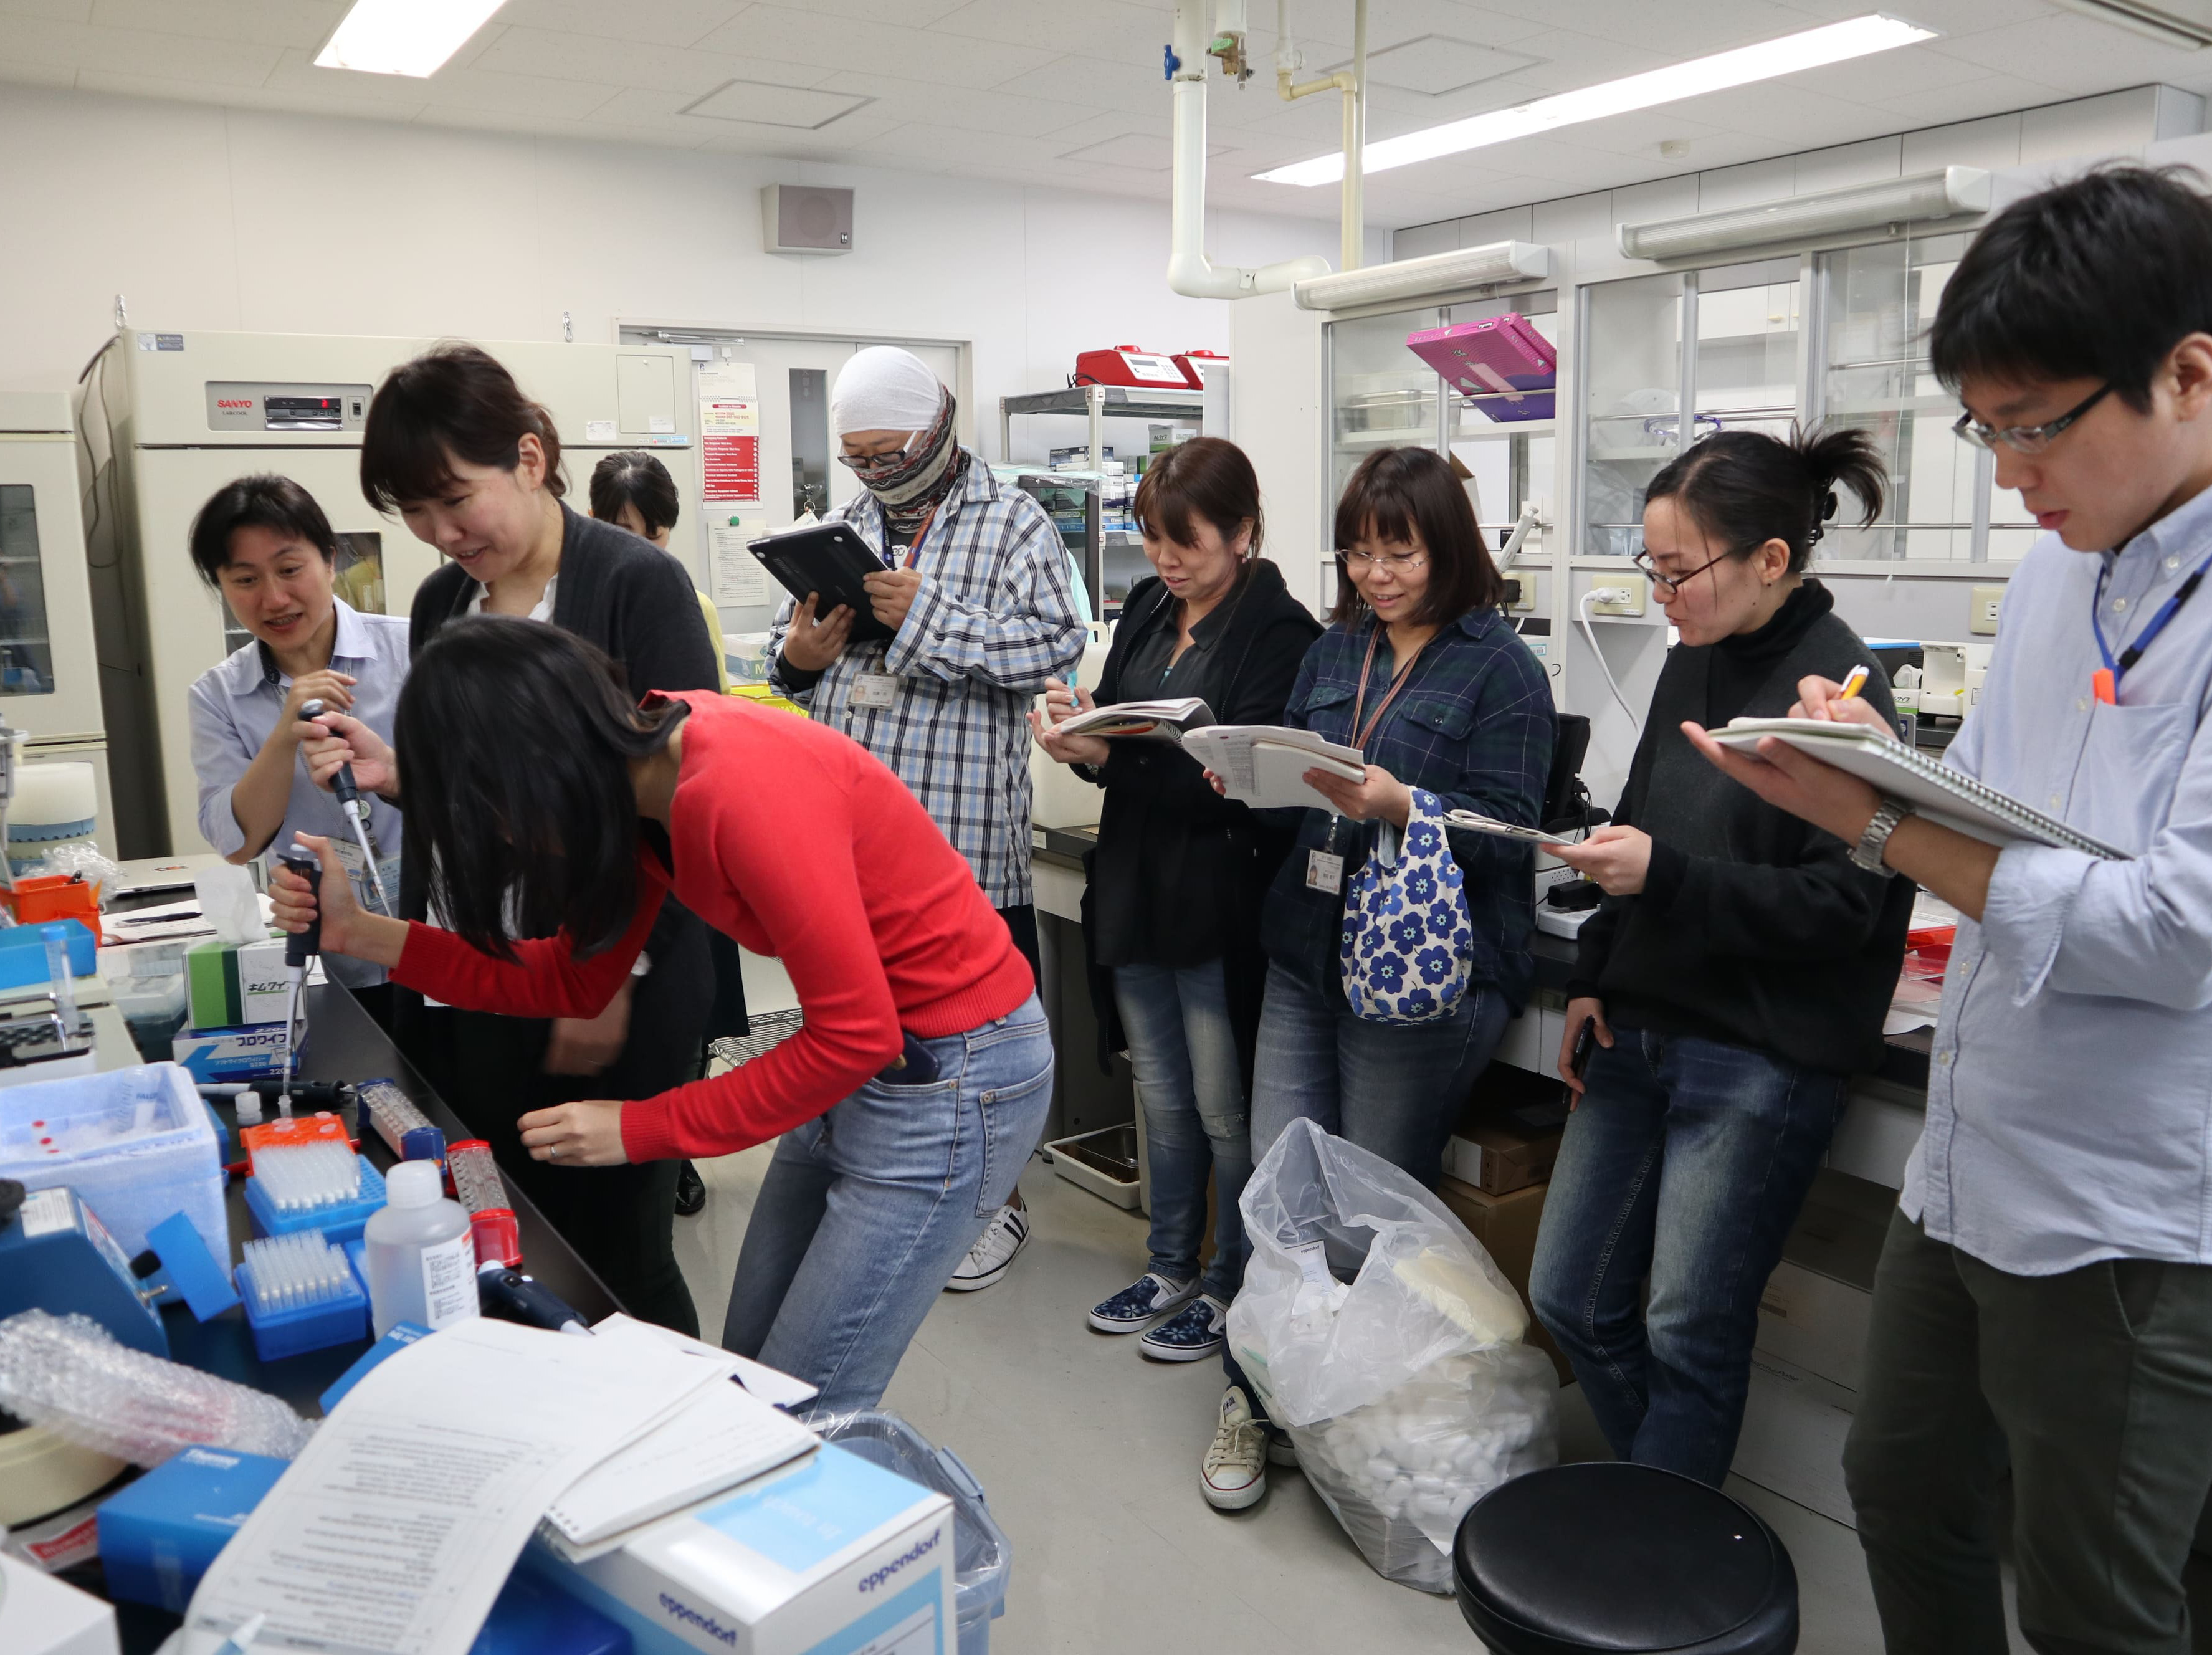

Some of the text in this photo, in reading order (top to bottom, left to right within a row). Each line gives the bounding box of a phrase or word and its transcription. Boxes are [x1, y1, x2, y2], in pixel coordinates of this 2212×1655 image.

[217, 399, 252, 408] SANYO
[249, 981, 287, 992] キムワイ
[1300, 1244, 1320, 1254] eppendorf
[858, 1528, 941, 1593] eppendorf
[659, 1591, 738, 1647] eppendorf
